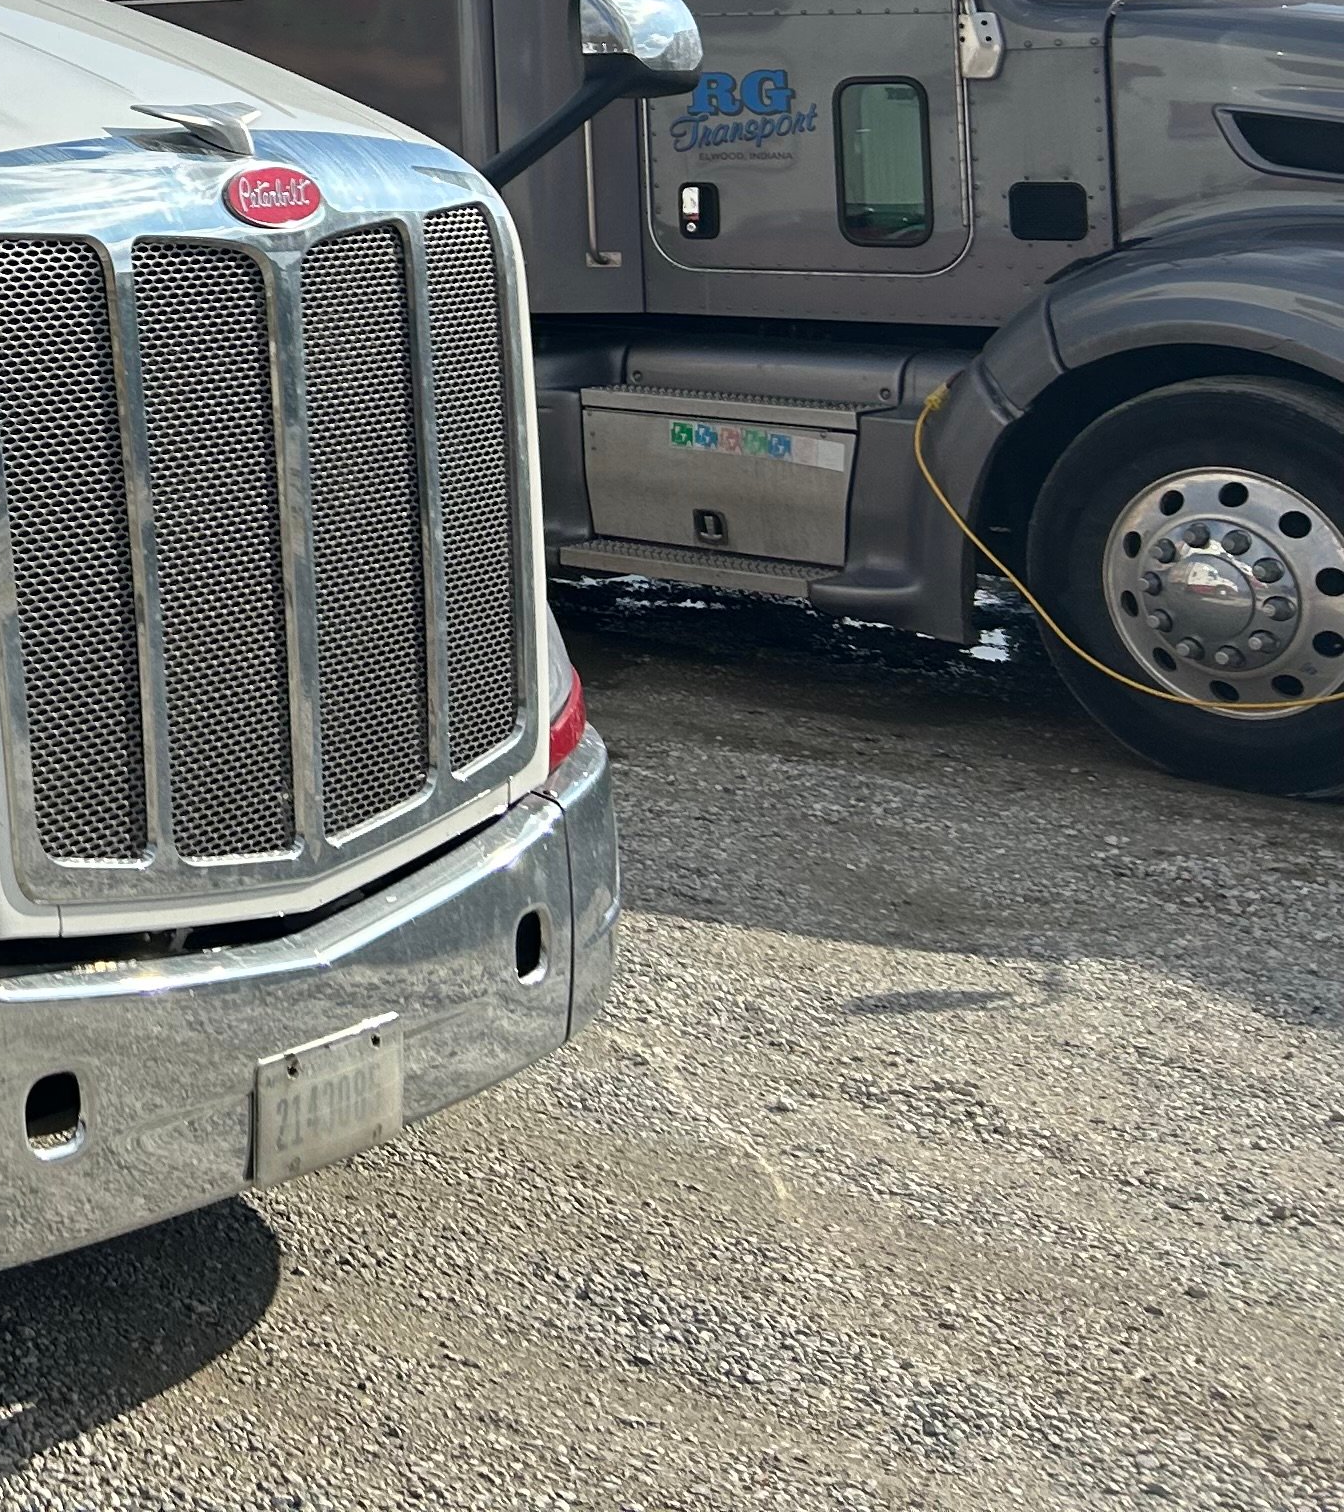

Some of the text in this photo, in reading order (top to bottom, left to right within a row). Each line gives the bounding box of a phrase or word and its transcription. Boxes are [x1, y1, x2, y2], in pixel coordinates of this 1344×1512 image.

[687, 68, 796, 117] RG
[670, 103, 818, 153] Transport
[237, 176, 311, 213] Peterbilt
